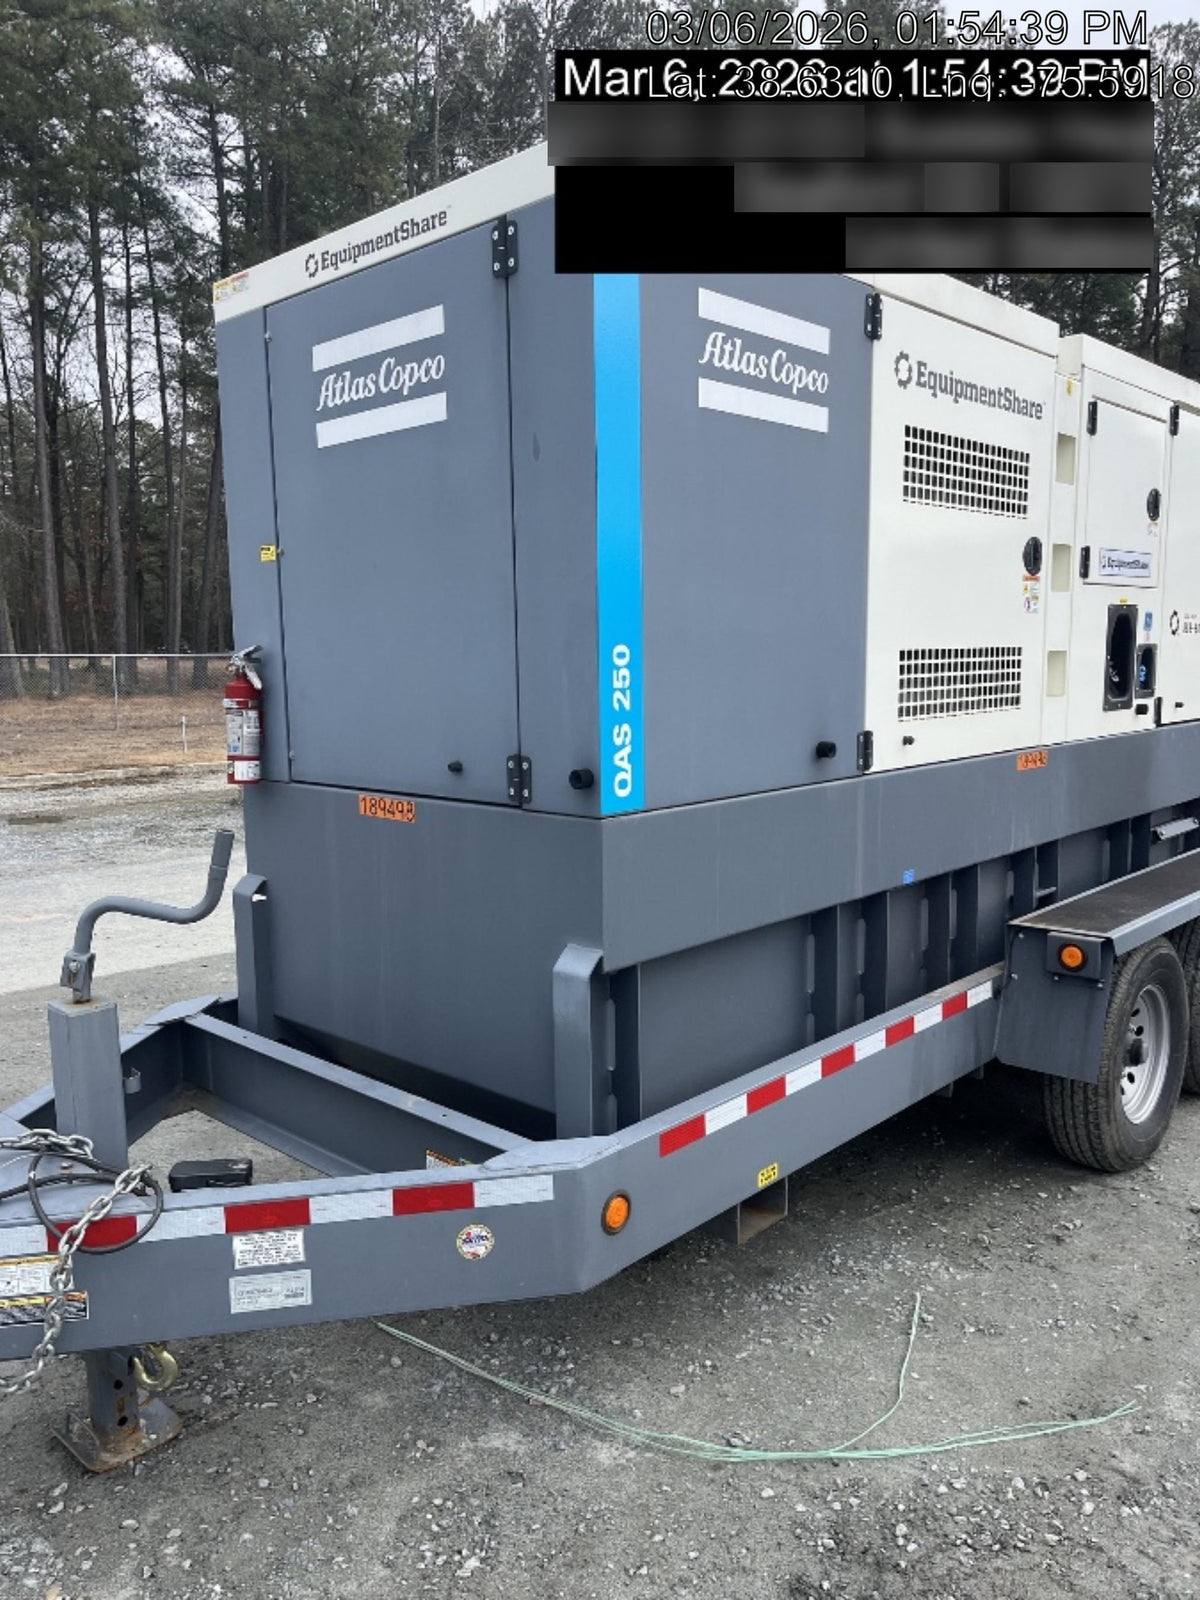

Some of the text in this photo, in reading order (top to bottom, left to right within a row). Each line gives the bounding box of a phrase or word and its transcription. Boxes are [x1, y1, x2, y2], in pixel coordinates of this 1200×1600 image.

[320, 210, 448, 271] EquipmentShare
[315, 354, 445, 412] Atlas Copco
[698, 331, 830, 395] Atlas Copco
[914, 360, 1044, 420] EquipmentShare
[612, 643, 633, 798] QAS 250
